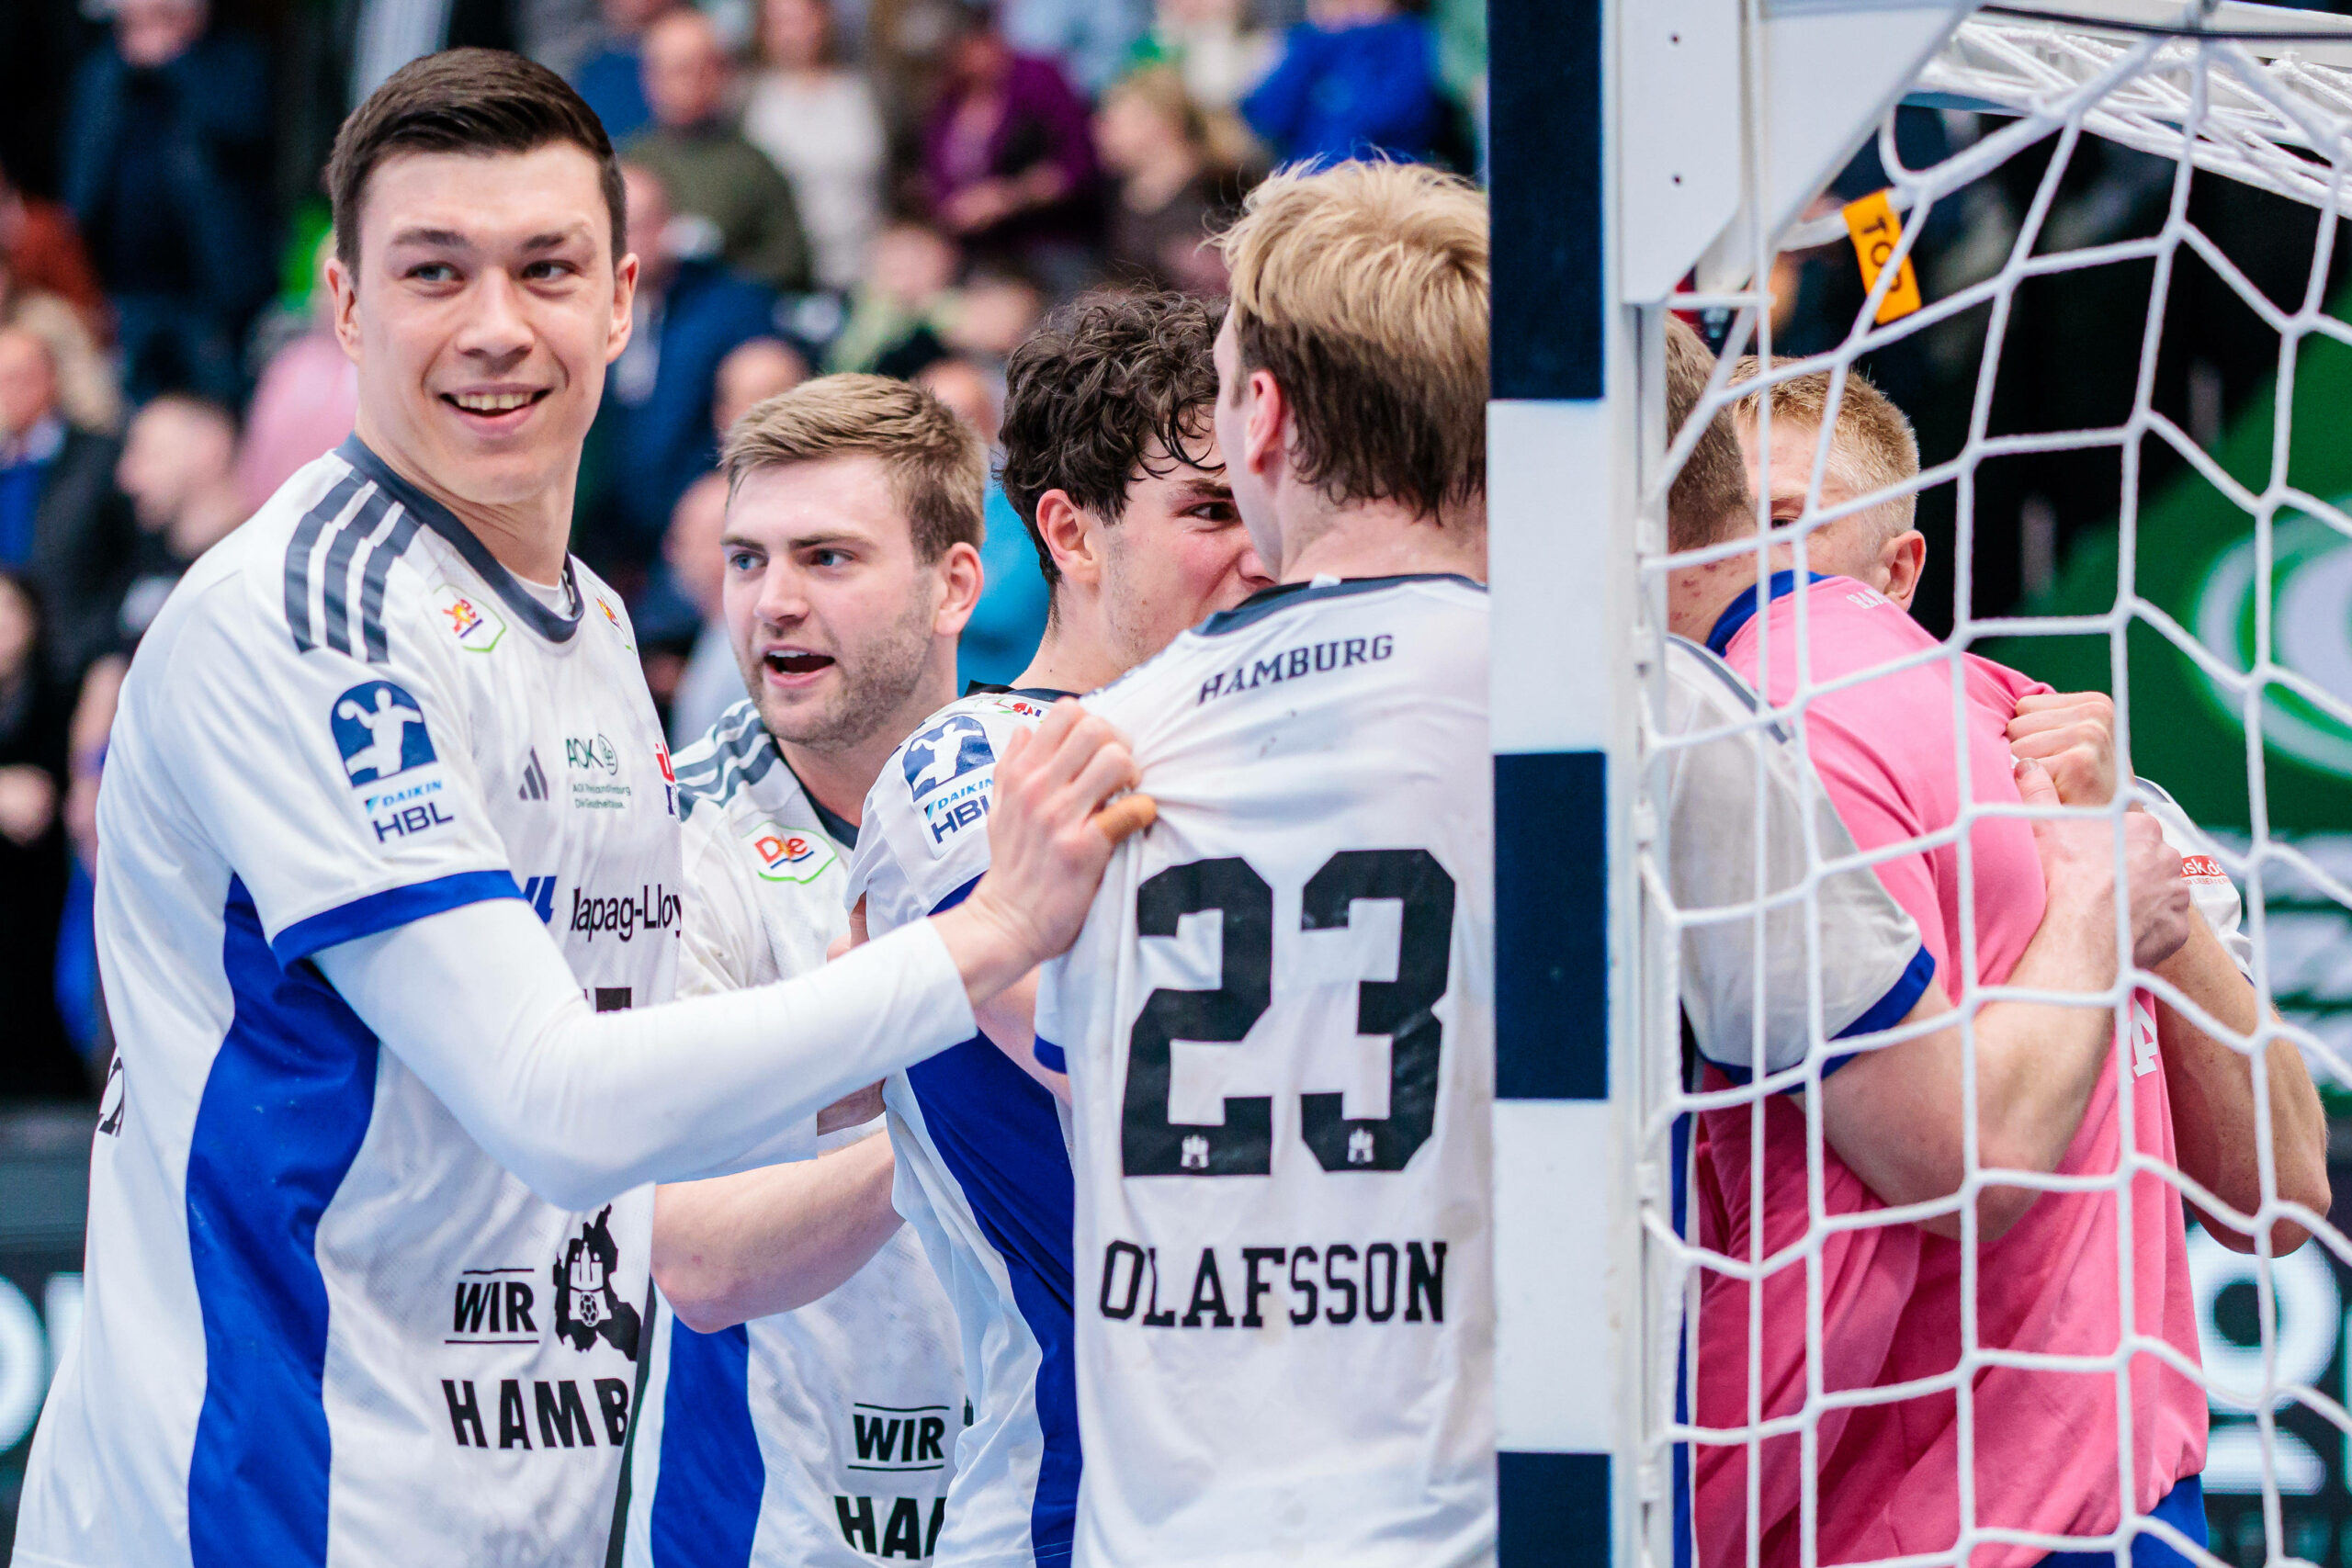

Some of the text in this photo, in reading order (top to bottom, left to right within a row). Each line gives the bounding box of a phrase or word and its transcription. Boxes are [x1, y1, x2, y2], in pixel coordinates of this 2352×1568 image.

[1197, 635, 1393, 705] HAMBURG
[566, 739, 605, 769] AOK
[382, 780, 443, 807] DAIKIN
[372, 801, 454, 843] HBL
[1121, 849, 1456, 1177] 23
[454, 1281, 538, 1333] WIR
[1100, 1240, 1447, 1328] OLAFSSON
[441, 1378, 629, 1450] HAMB
[853, 1414, 944, 1462] WIR
